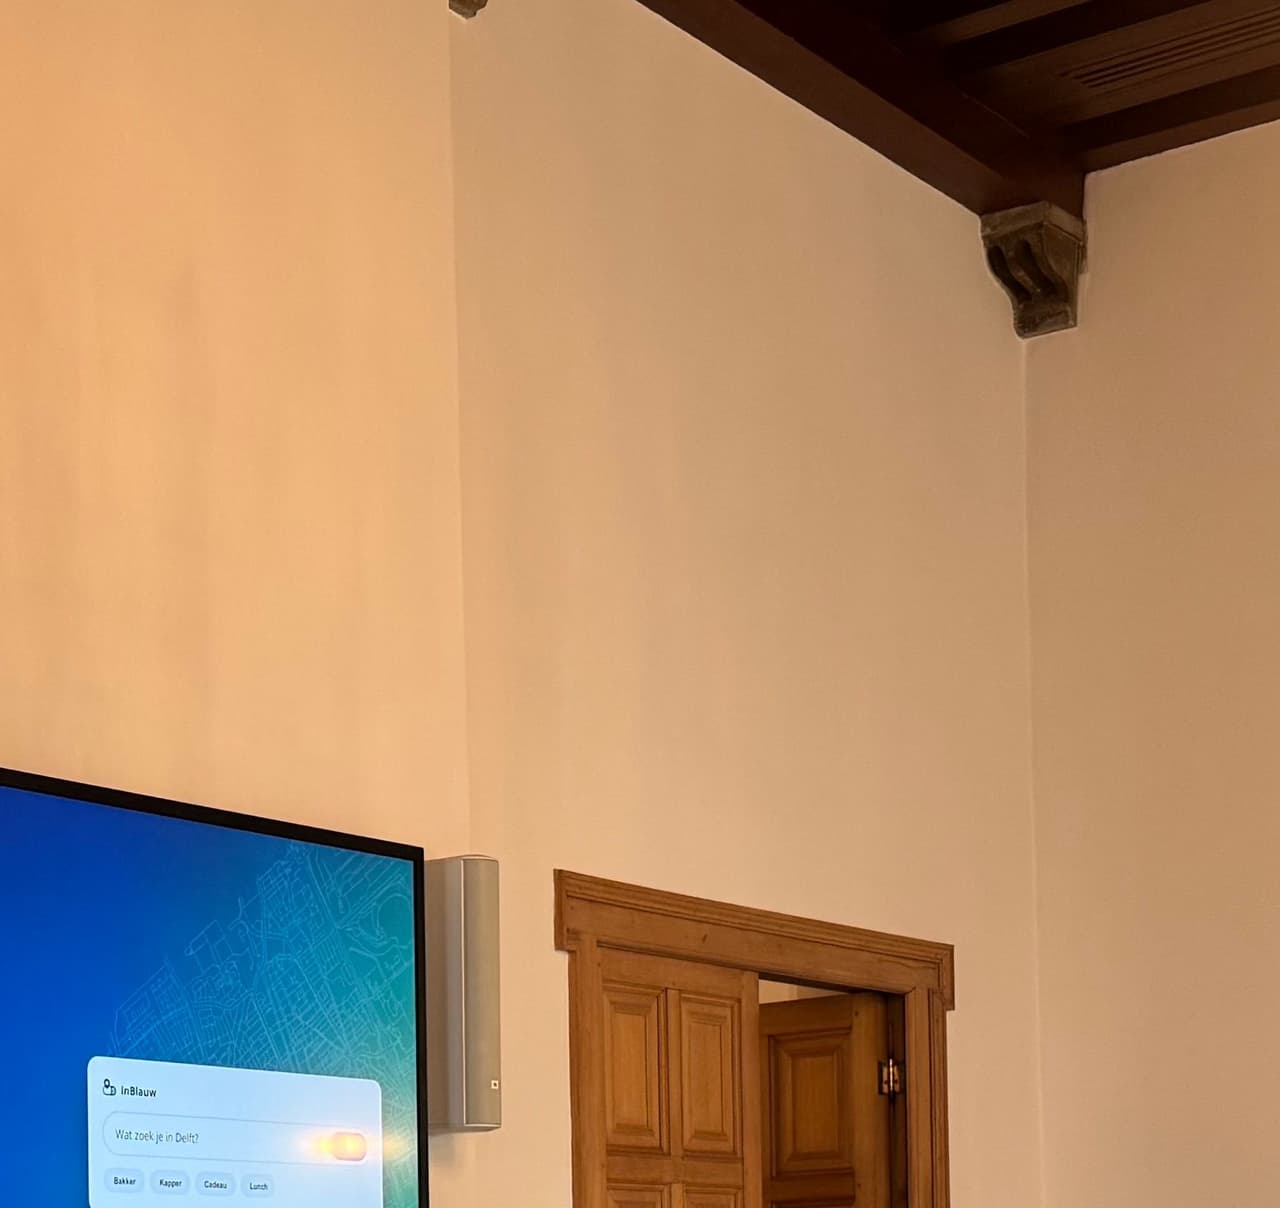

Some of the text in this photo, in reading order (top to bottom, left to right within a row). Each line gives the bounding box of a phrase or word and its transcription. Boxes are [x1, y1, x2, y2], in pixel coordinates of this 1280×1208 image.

[120, 1085, 157, 1097] InBlauw
[115, 1128, 199, 1145] Wat zoek je in Delft?
[113, 1176, 136, 1186] Bakker
[159, 1178, 182, 1188] Kapper
[204, 1180, 227, 1190] Cadeau
[249, 1182, 269, 1191] Lunch
